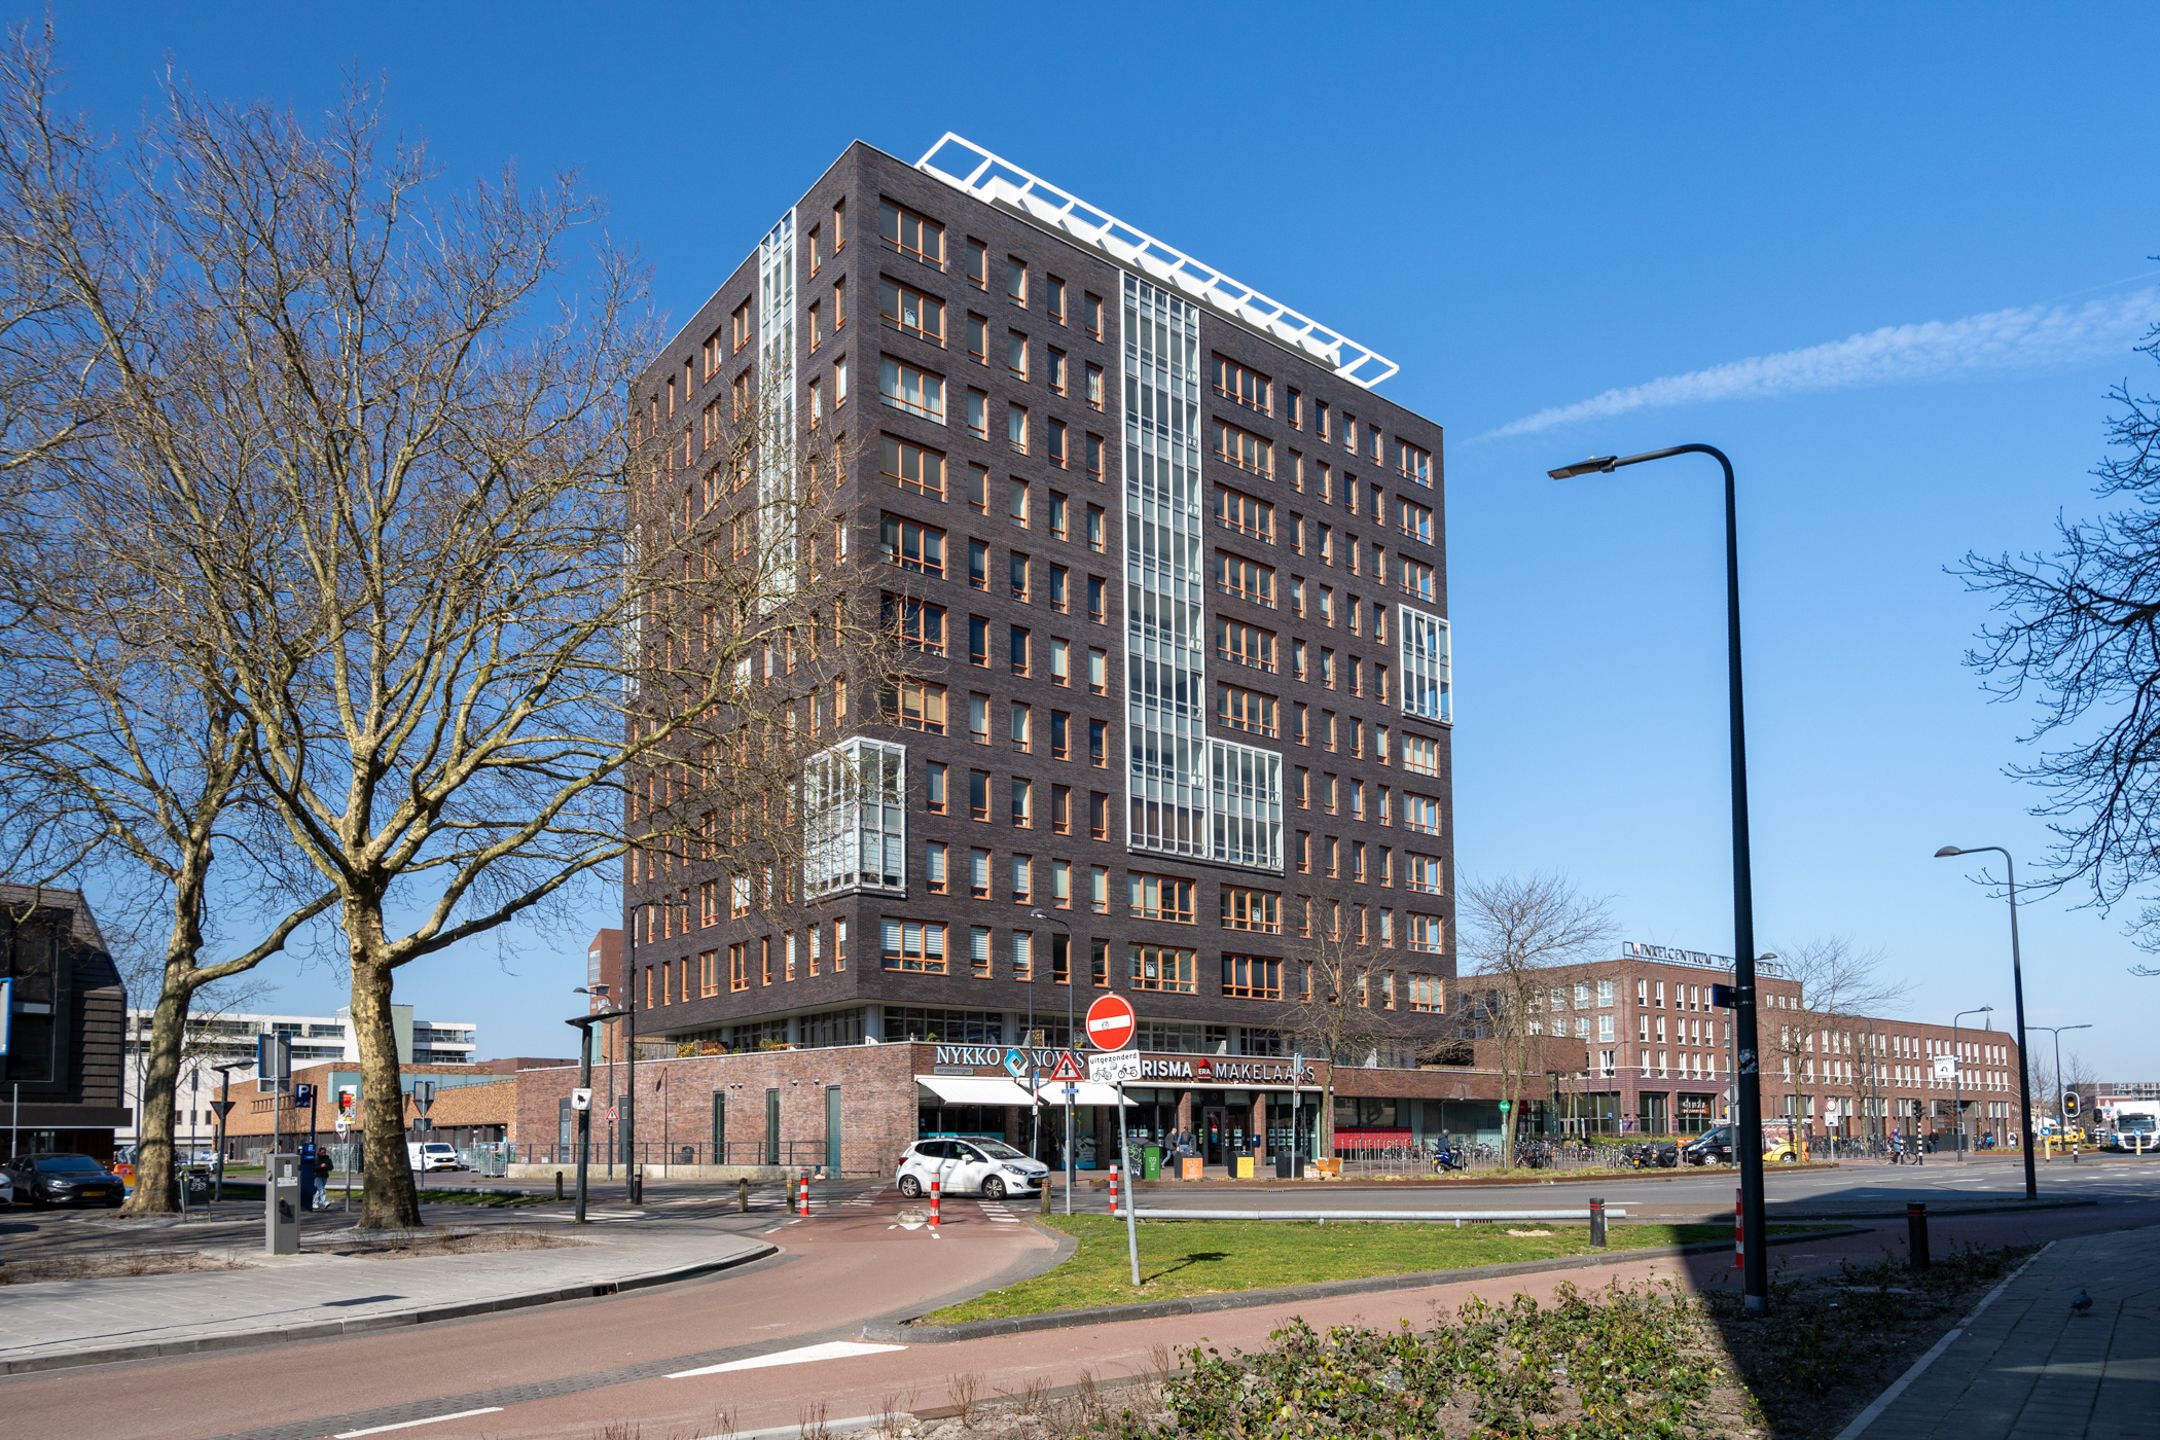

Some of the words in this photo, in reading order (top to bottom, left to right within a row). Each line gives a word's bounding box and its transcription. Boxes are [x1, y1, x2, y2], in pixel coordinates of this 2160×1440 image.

[936, 1046, 1000, 1066] NYKKO
[1090, 1052, 1138, 1065] uitgezonderd
[1142, 1060, 1193, 1078] RISMA
[298, 1084, 310, 1098] P
